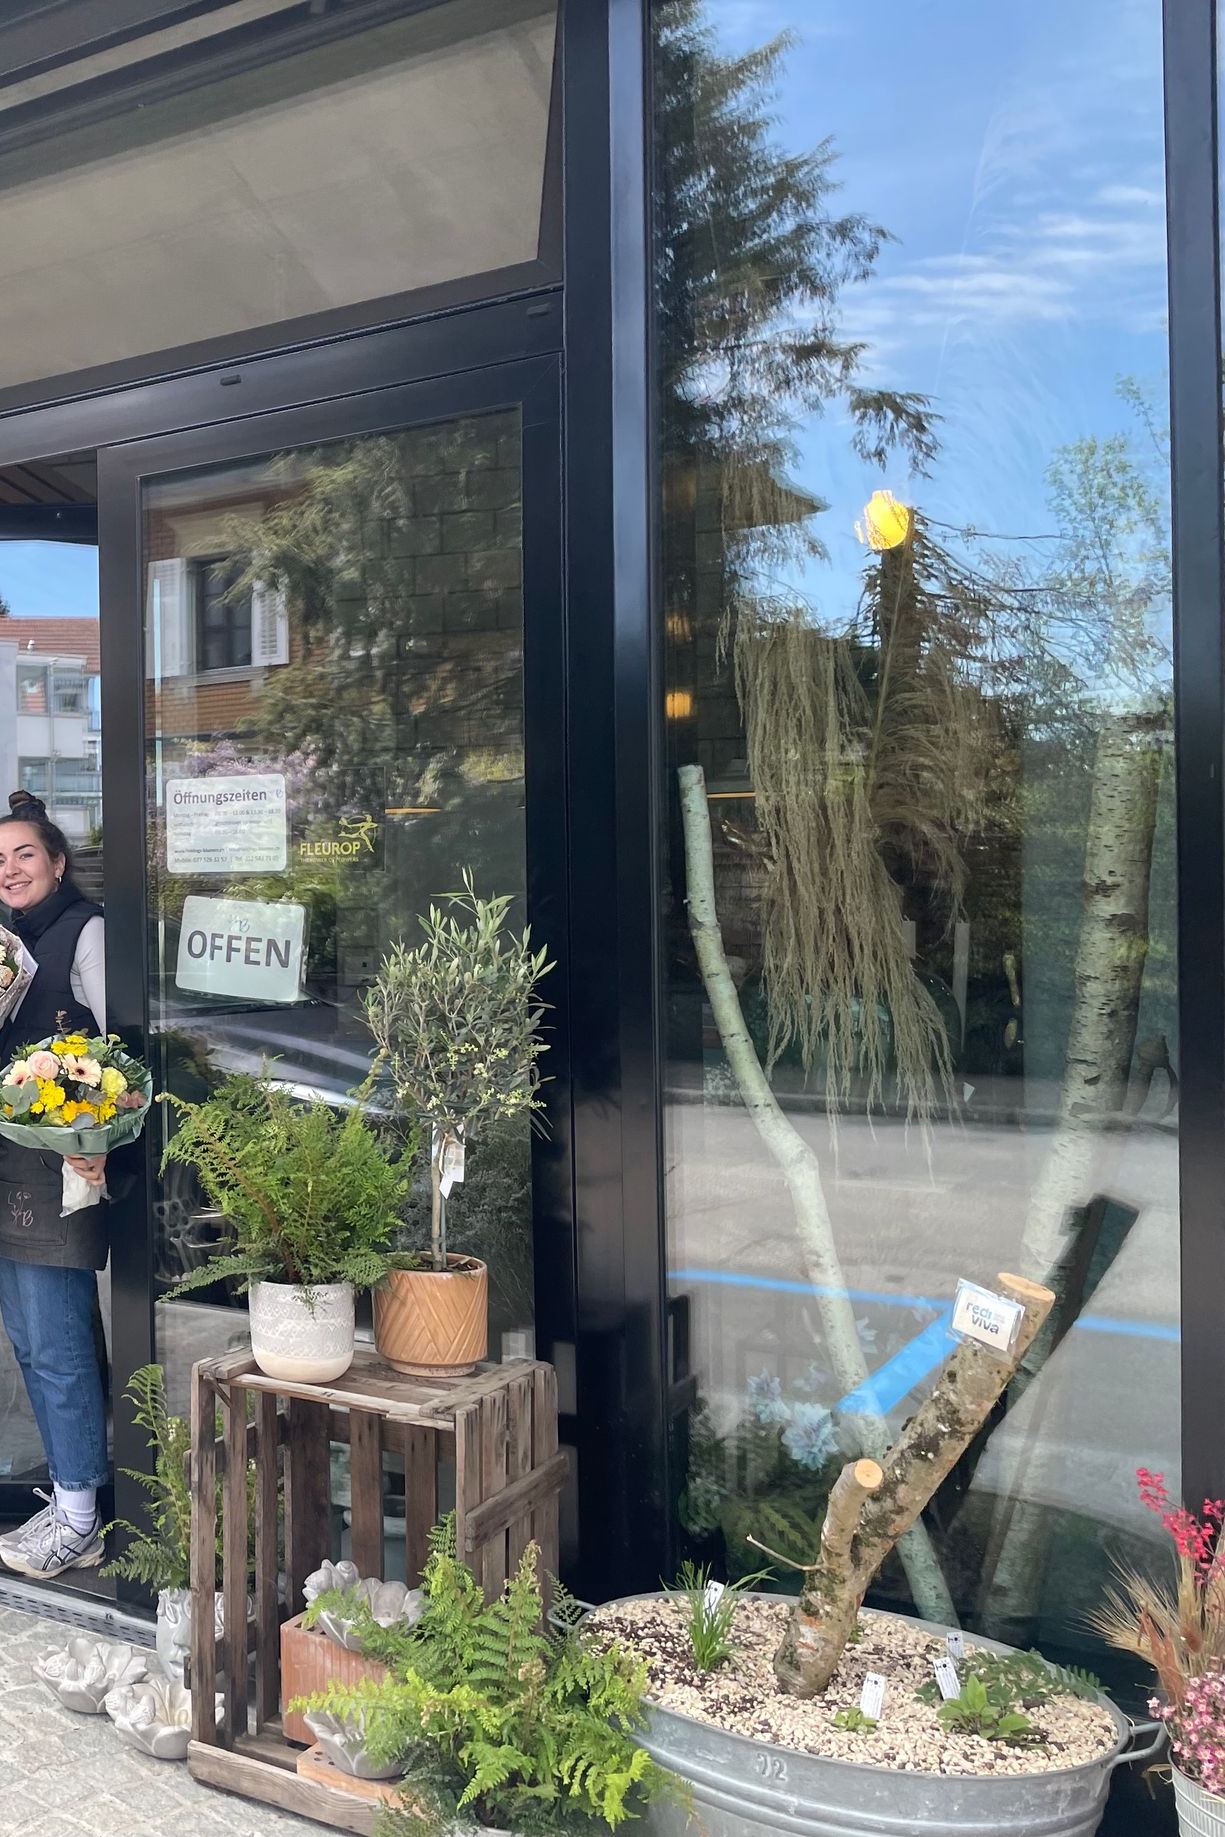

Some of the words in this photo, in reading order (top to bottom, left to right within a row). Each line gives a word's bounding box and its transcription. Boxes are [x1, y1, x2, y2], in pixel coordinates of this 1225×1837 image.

[173, 789, 267, 806] Öffnungszeiten
[300, 841, 361, 856] FLEUROP
[187, 930, 291, 969] OFFEN
[971, 1314, 1000, 1335] viva
